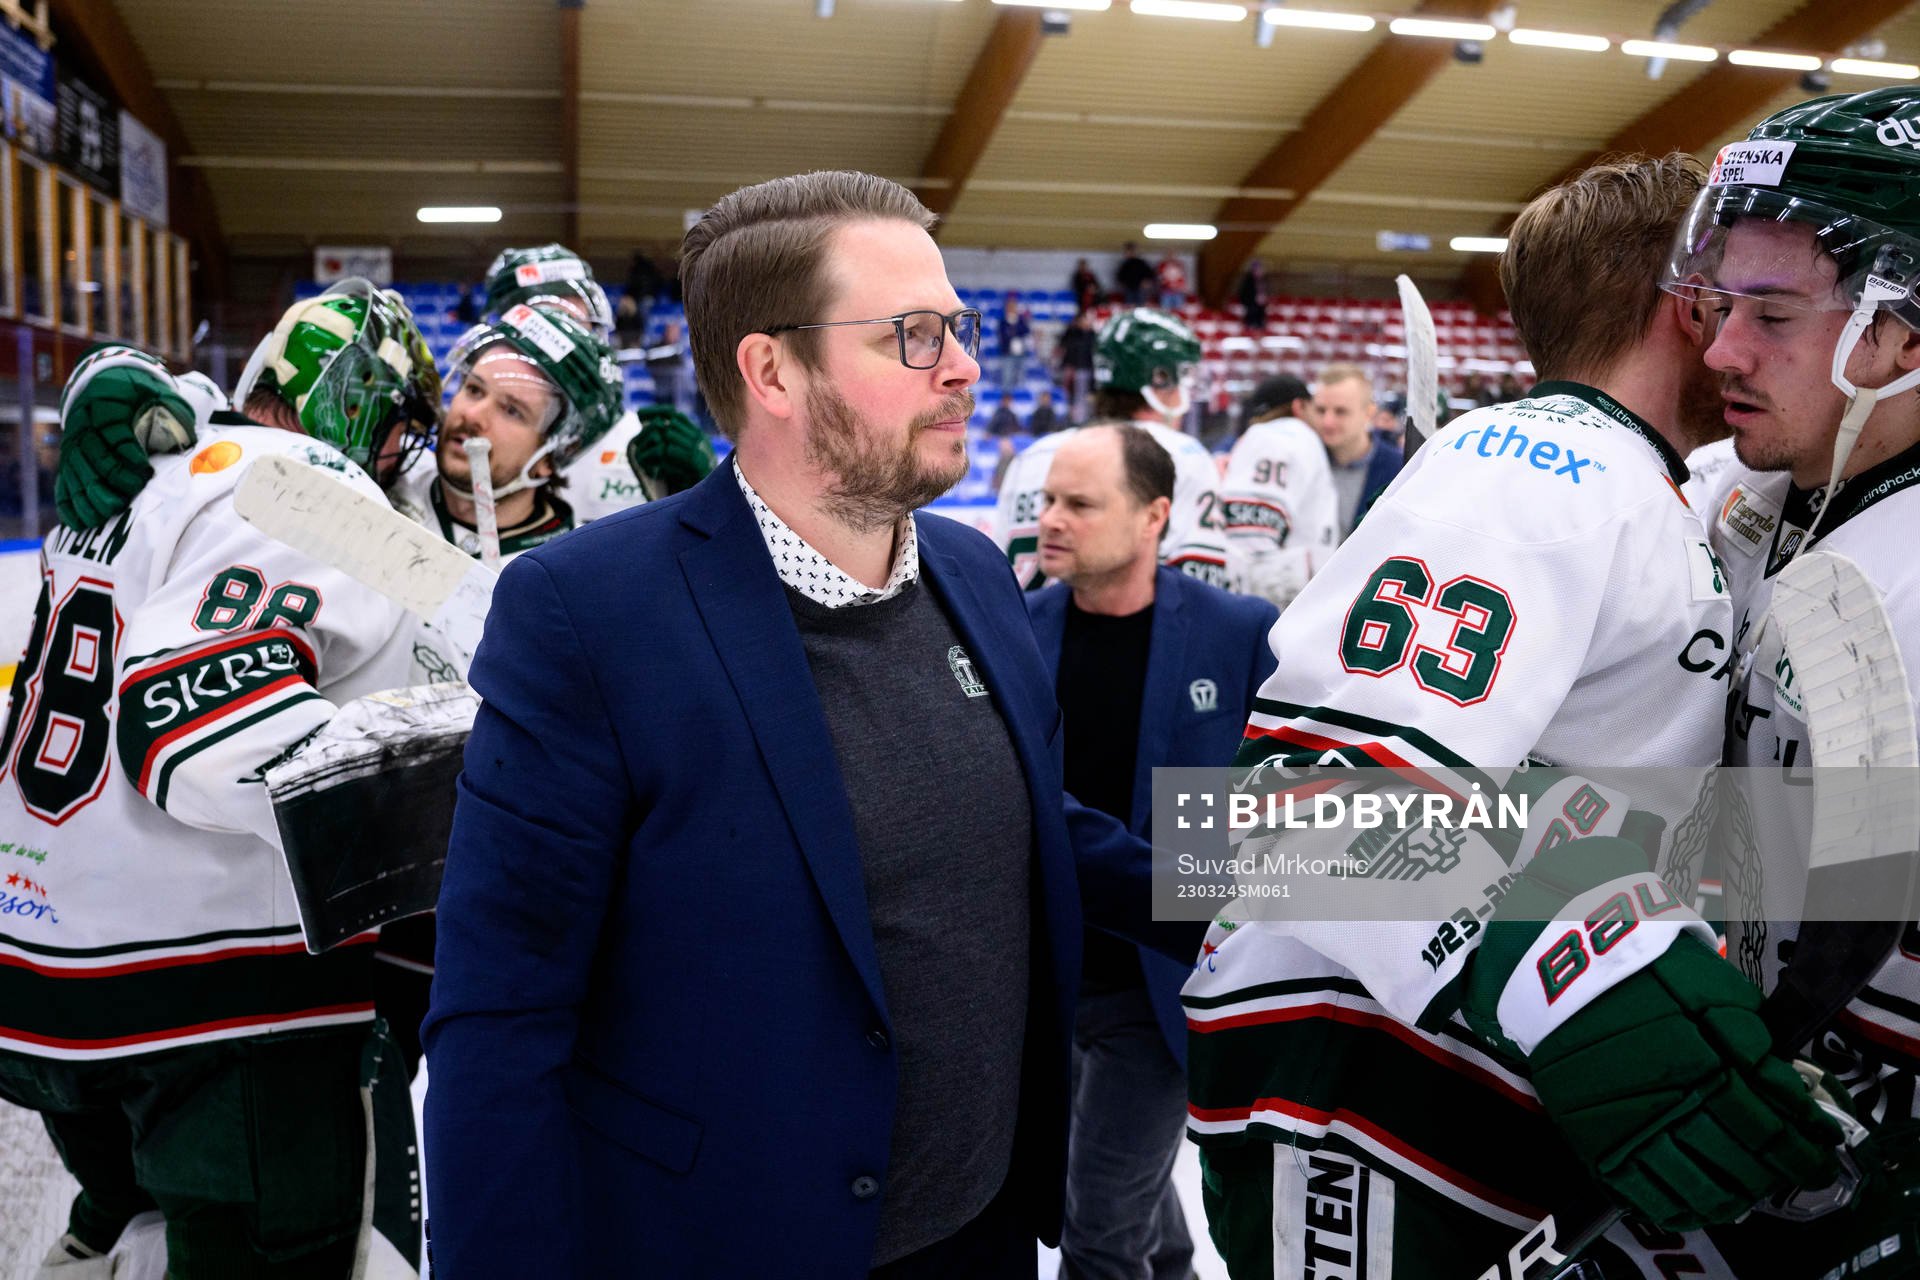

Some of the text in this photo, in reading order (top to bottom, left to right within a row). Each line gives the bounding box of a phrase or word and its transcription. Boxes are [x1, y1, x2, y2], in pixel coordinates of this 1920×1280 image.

[1724, 150, 1784, 166] SVENSKA
[1721, 167, 1744, 183] SPEL
[1338, 556, 1517, 708] 63
